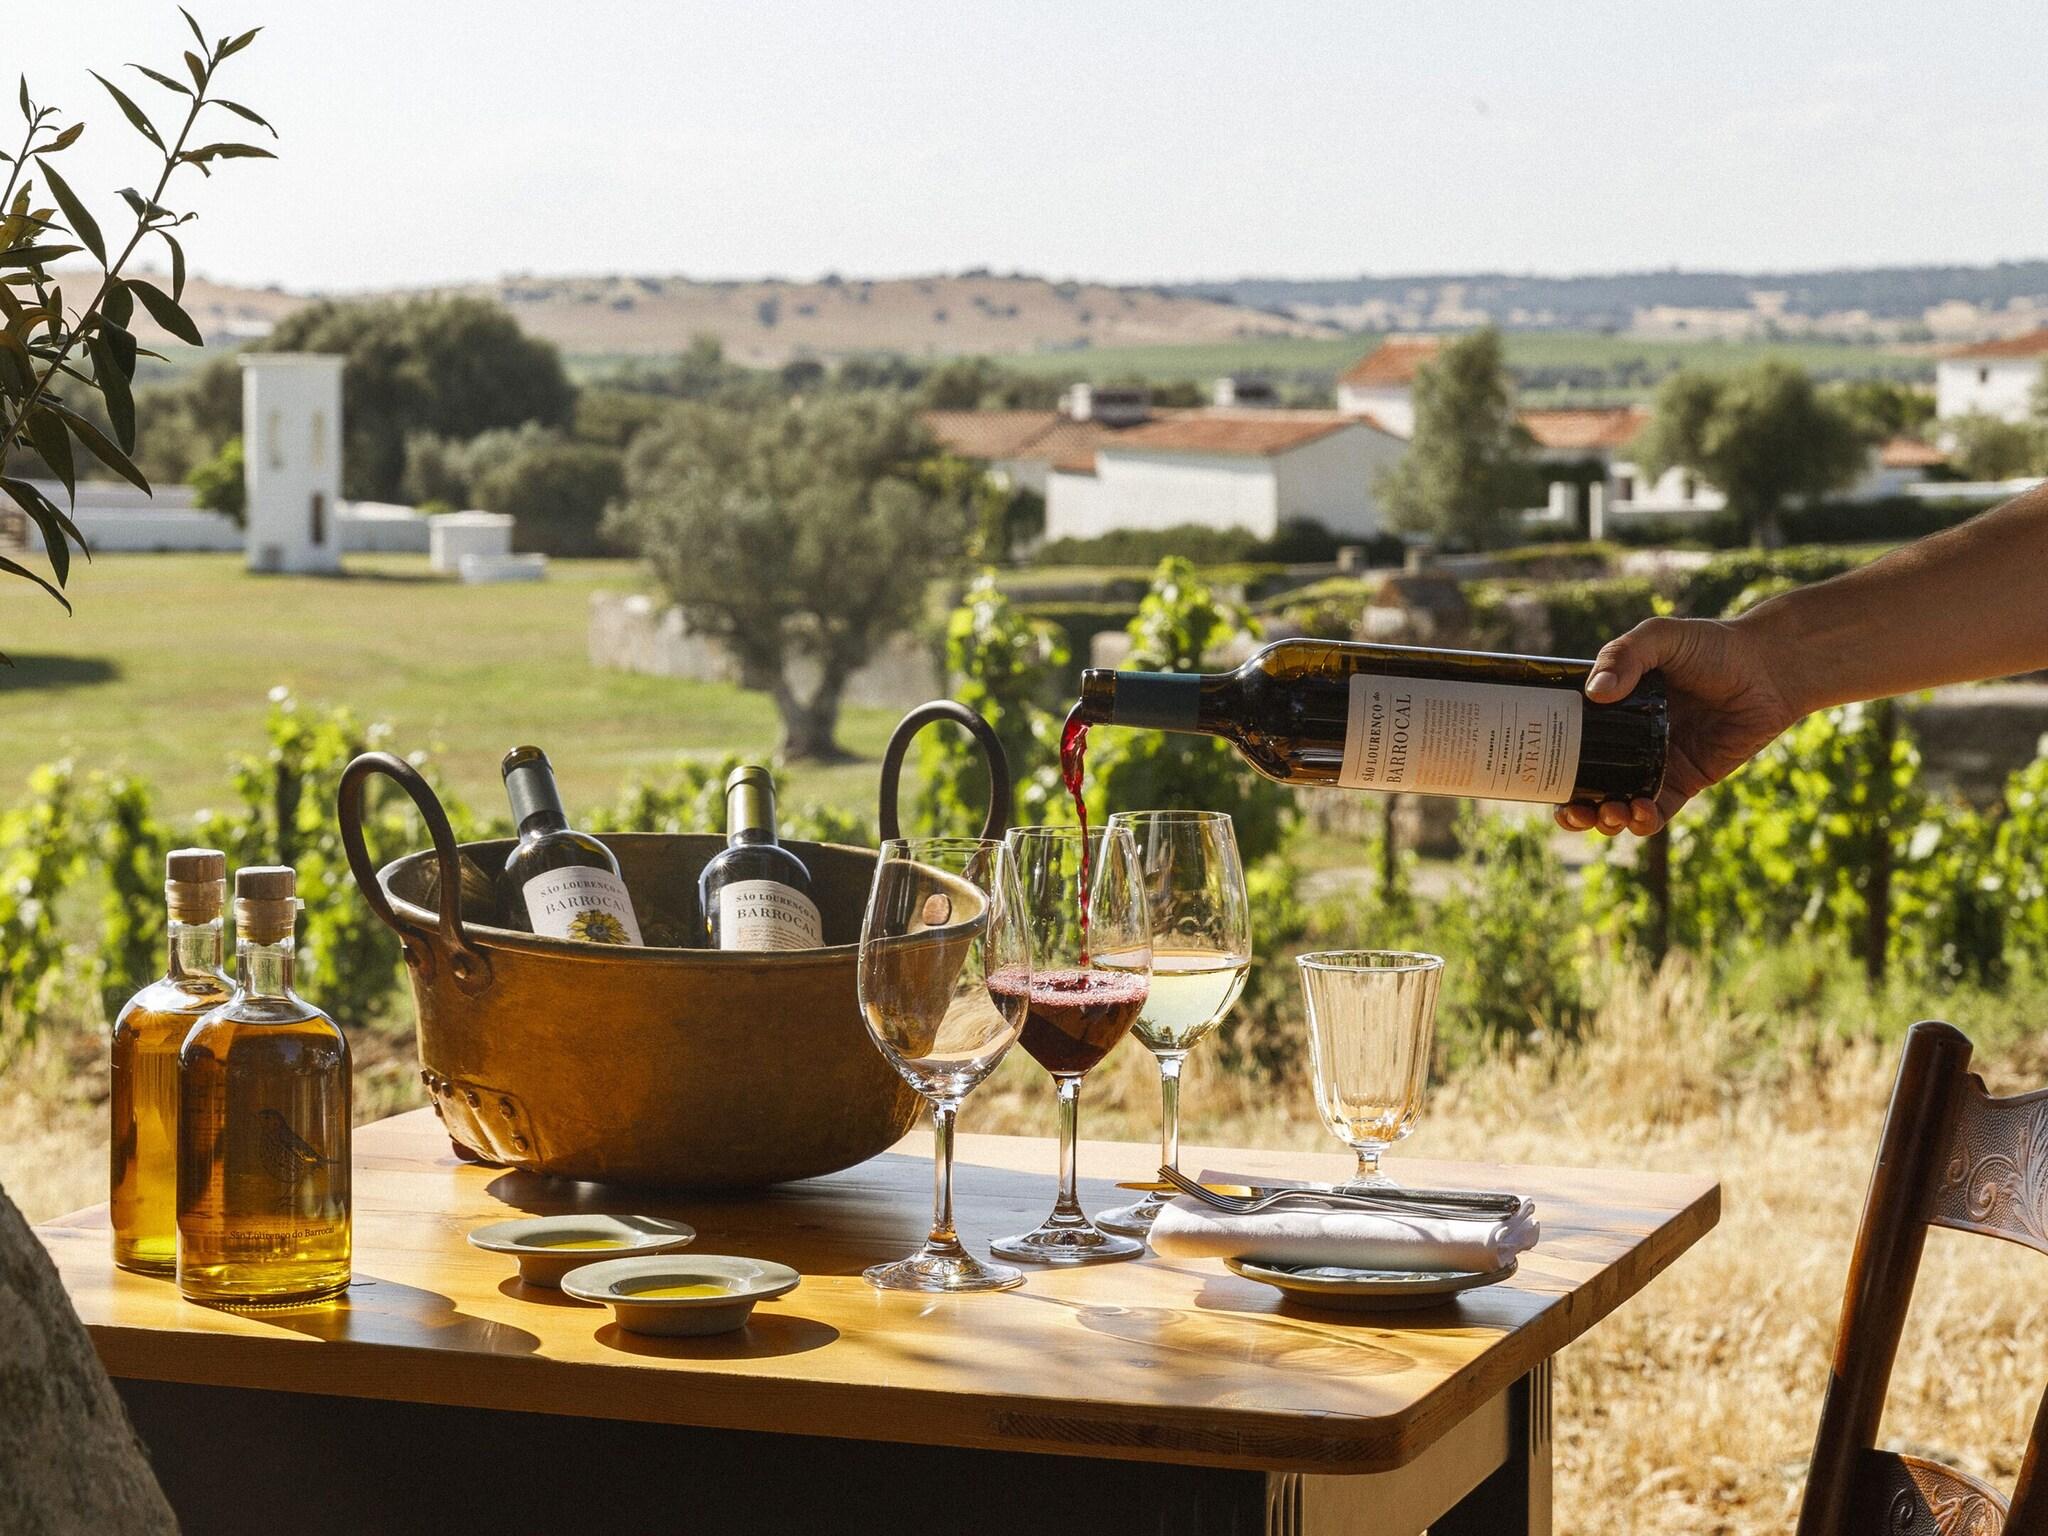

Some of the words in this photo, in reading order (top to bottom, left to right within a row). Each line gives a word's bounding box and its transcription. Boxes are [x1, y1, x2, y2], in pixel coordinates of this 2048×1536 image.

[1367, 704, 1385, 765] LOURENÇO
[1386, 694, 1411, 783] BARROCAL
[1521, 722, 1542, 783] SYRAH
[1362, 766, 1376, 782] SÃO
[541, 885, 560, 897] SÃO
[563, 880, 616, 893] LOURENÇO
[545, 895, 629, 915] BARROCAL
[736, 893, 756, 902] SÃO
[760, 894, 809, 916] LOURENÇO
[737, 908, 817, 940] BARROCAL
[292, 1229, 303, 1239] do
[305, 1225, 335, 1238] Barrocal
